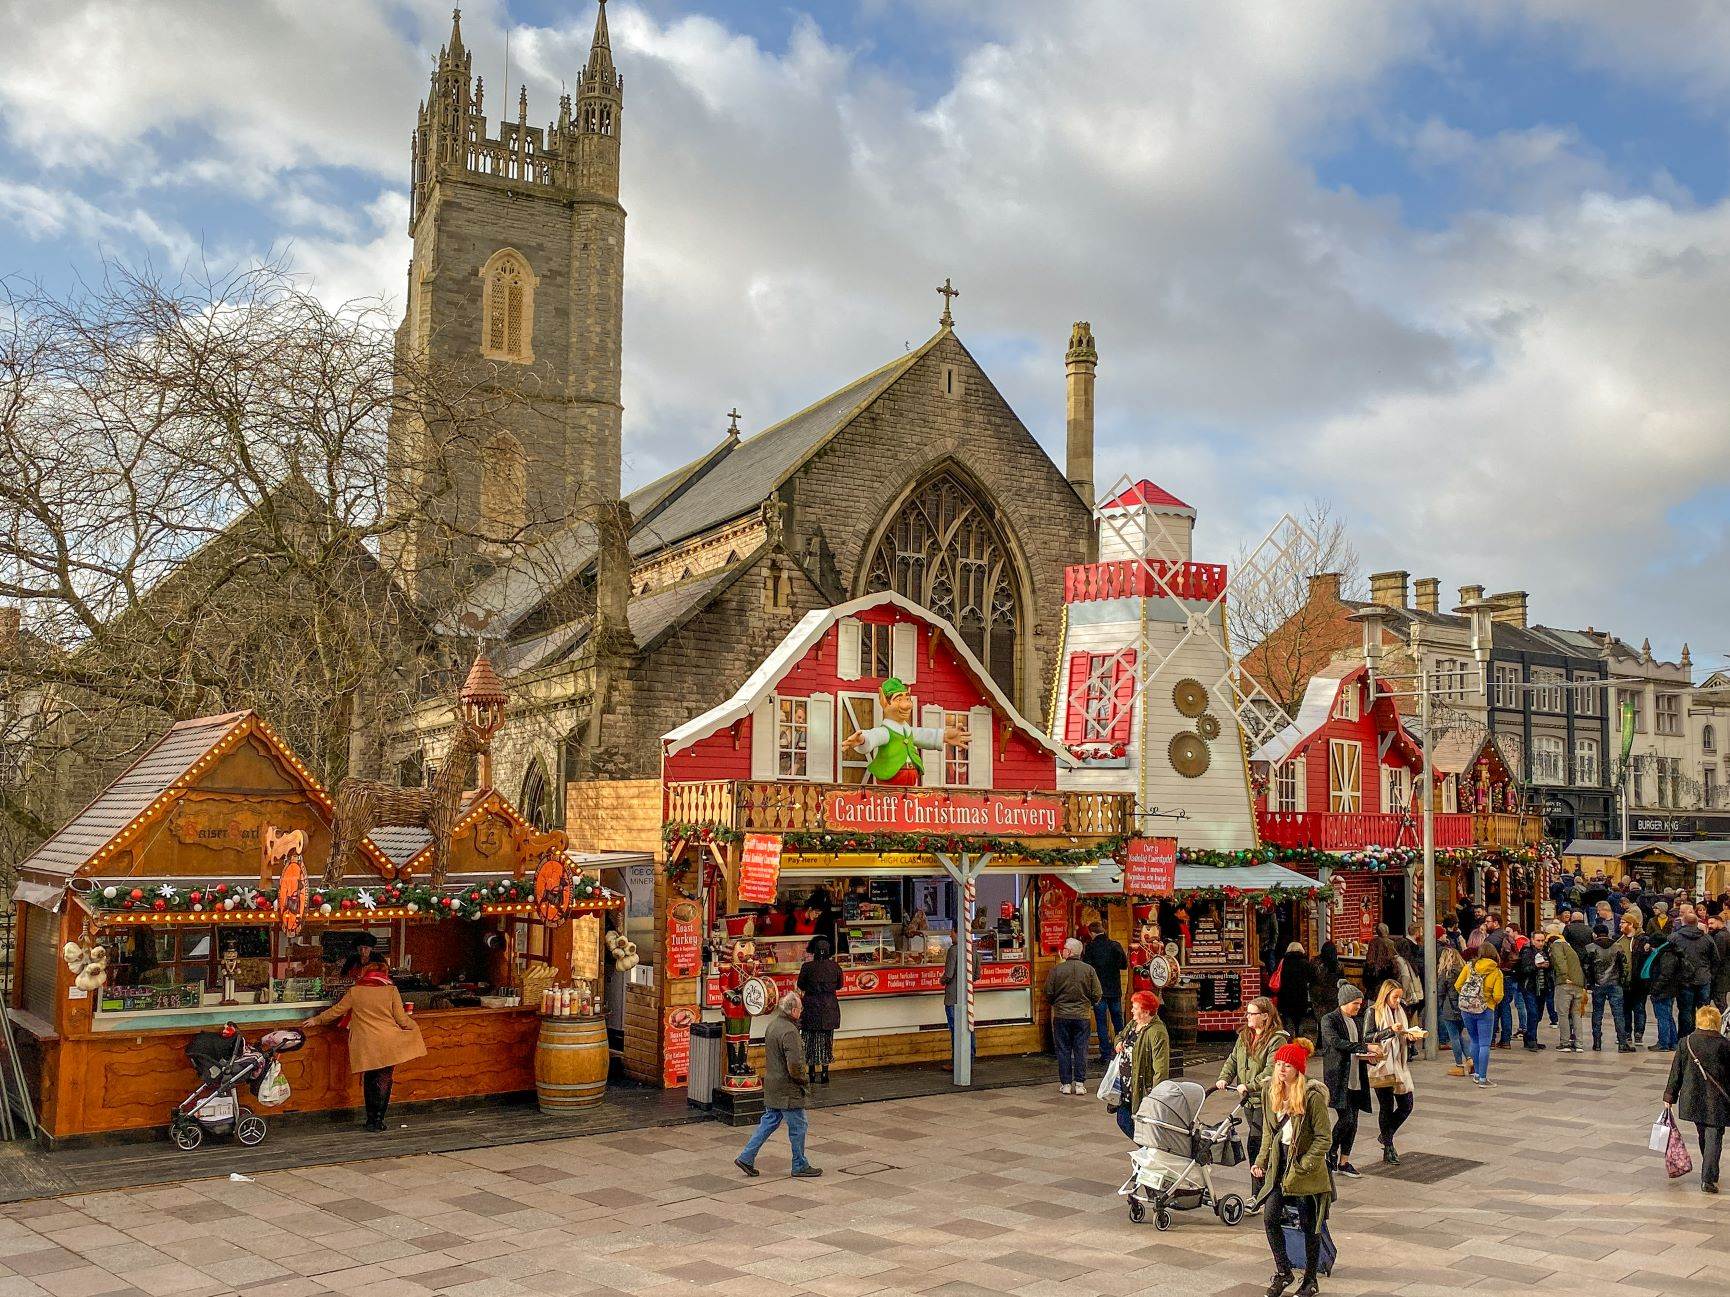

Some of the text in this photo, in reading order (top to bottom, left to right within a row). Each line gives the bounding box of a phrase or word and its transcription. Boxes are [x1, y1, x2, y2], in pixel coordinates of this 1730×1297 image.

[835, 796, 1056, 831] Cardiff Christmas Carvery
[1637, 819, 1679, 831] BURGER KNG
[787, 856, 800, 865] Pay
[880, 856, 898, 864] HIGH
[631, 868, 645, 876] ICE
[676, 924, 693, 933] Roast
[672, 933, 698, 946] Turkey
